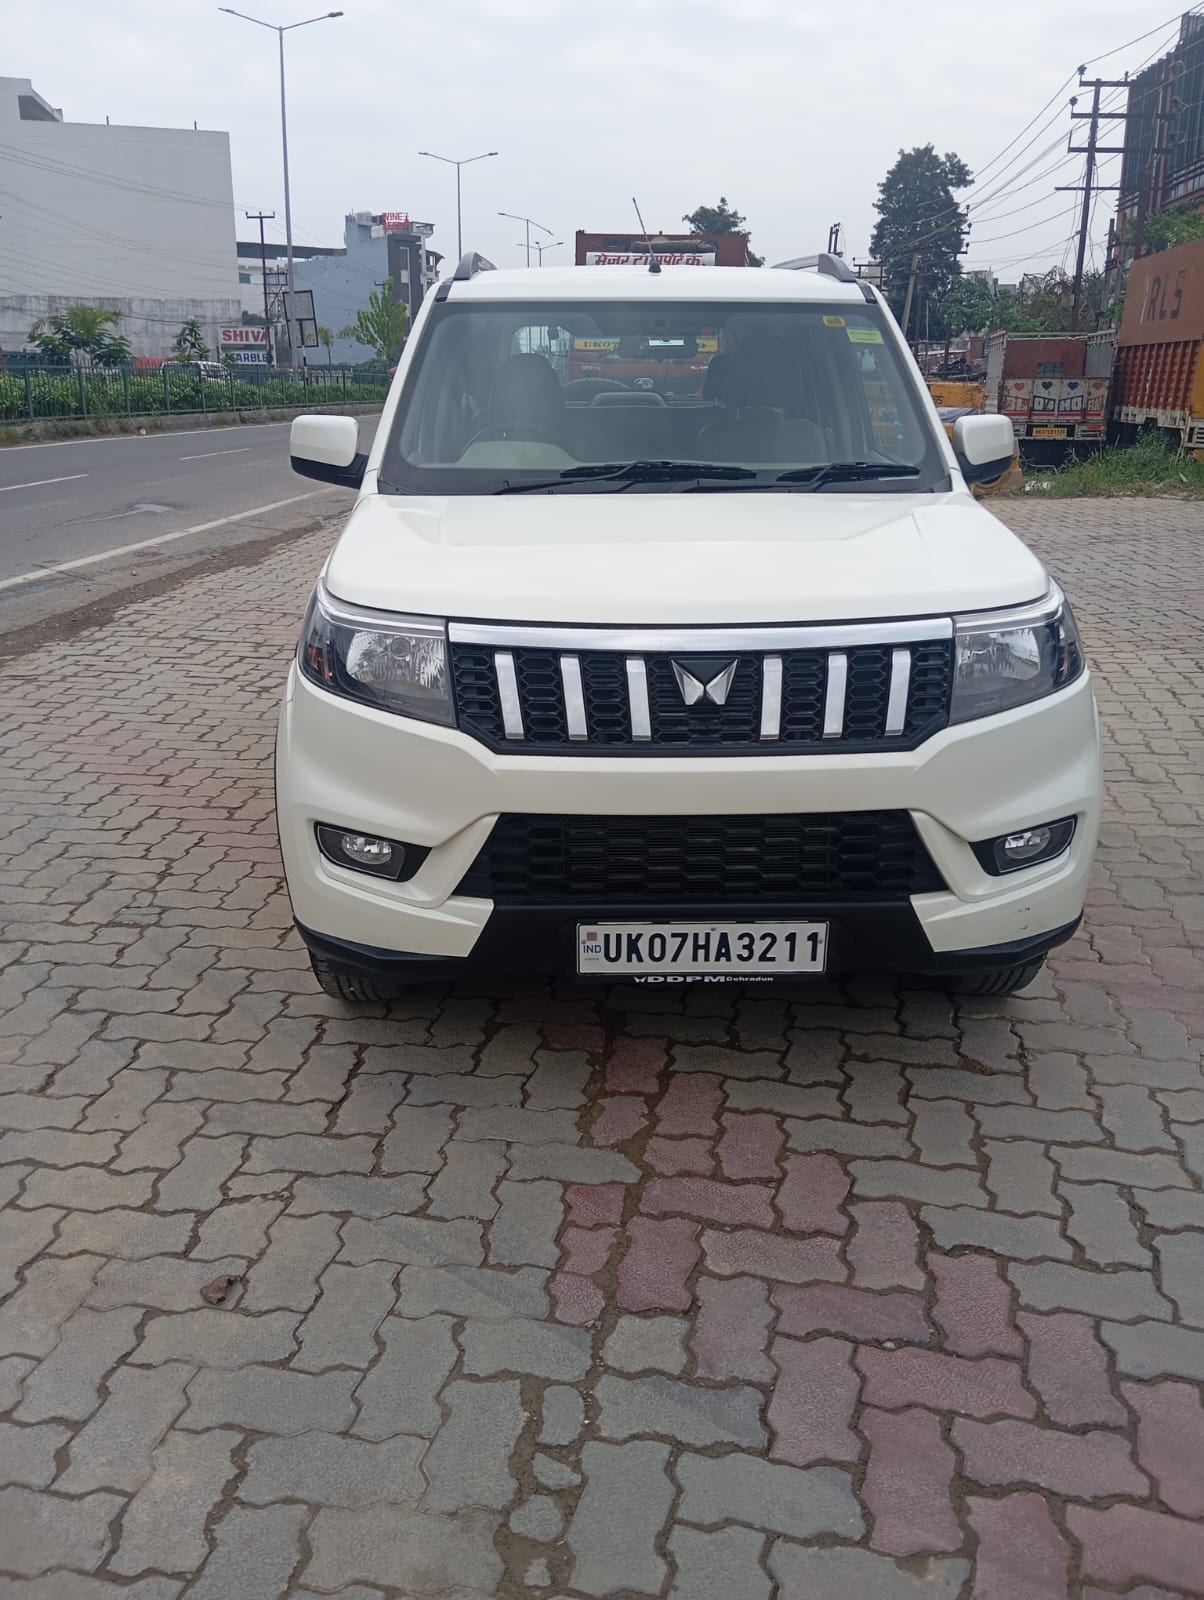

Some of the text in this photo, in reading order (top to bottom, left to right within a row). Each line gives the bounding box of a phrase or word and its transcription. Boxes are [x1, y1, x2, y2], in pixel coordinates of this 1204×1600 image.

[222, 330, 269, 342] SHIVA
[583, 944, 602, 954] IND
[603, 932, 819, 963] UK07HA3211
